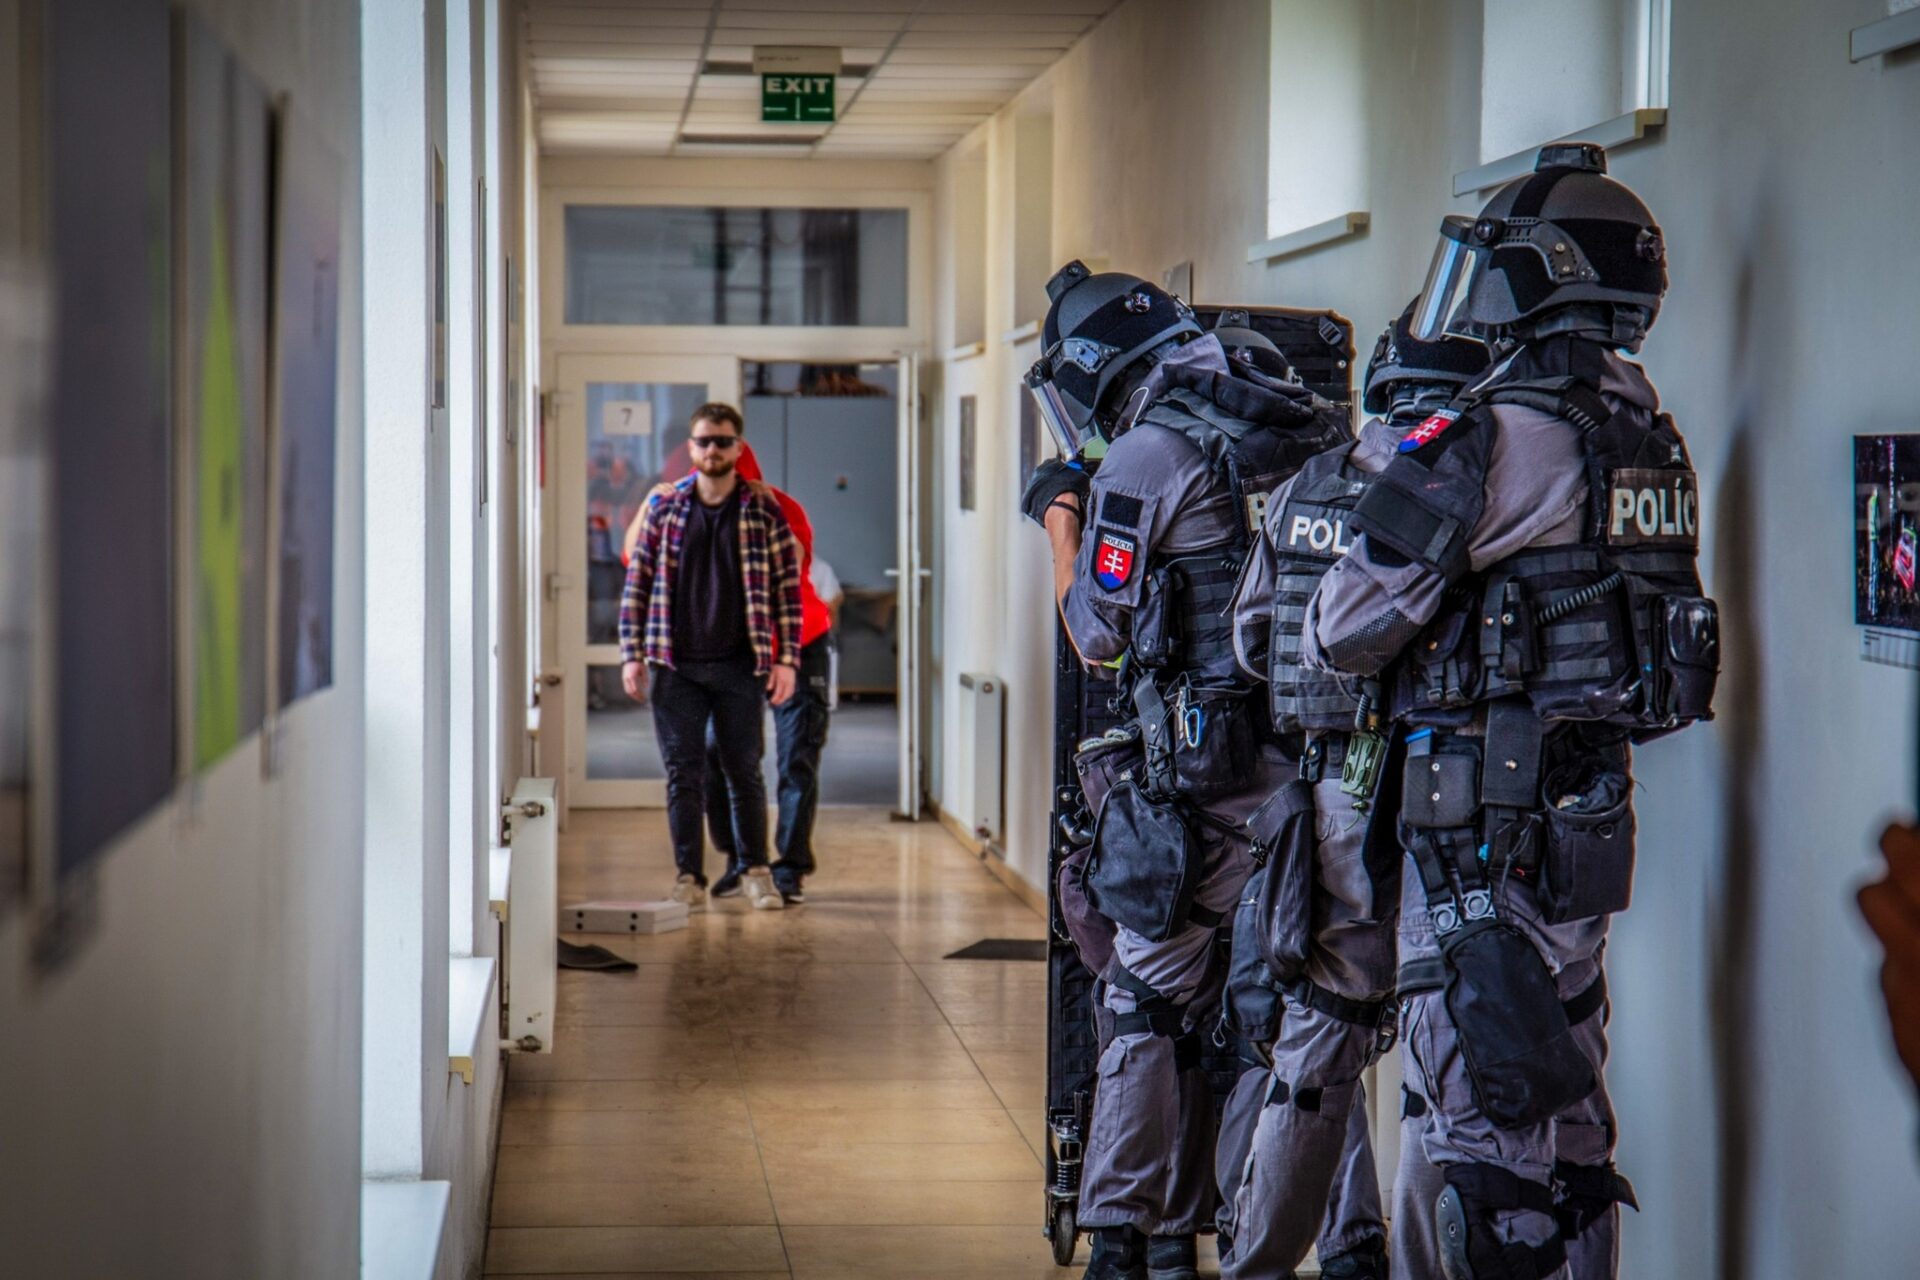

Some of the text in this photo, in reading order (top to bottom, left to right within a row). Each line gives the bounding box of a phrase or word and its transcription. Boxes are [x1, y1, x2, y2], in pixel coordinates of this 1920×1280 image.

[765, 78, 831, 94] EXIT
[621, 408, 633, 427] 7
[1611, 478, 1696, 536] POLÍC
[1289, 515, 1349, 554] POL
